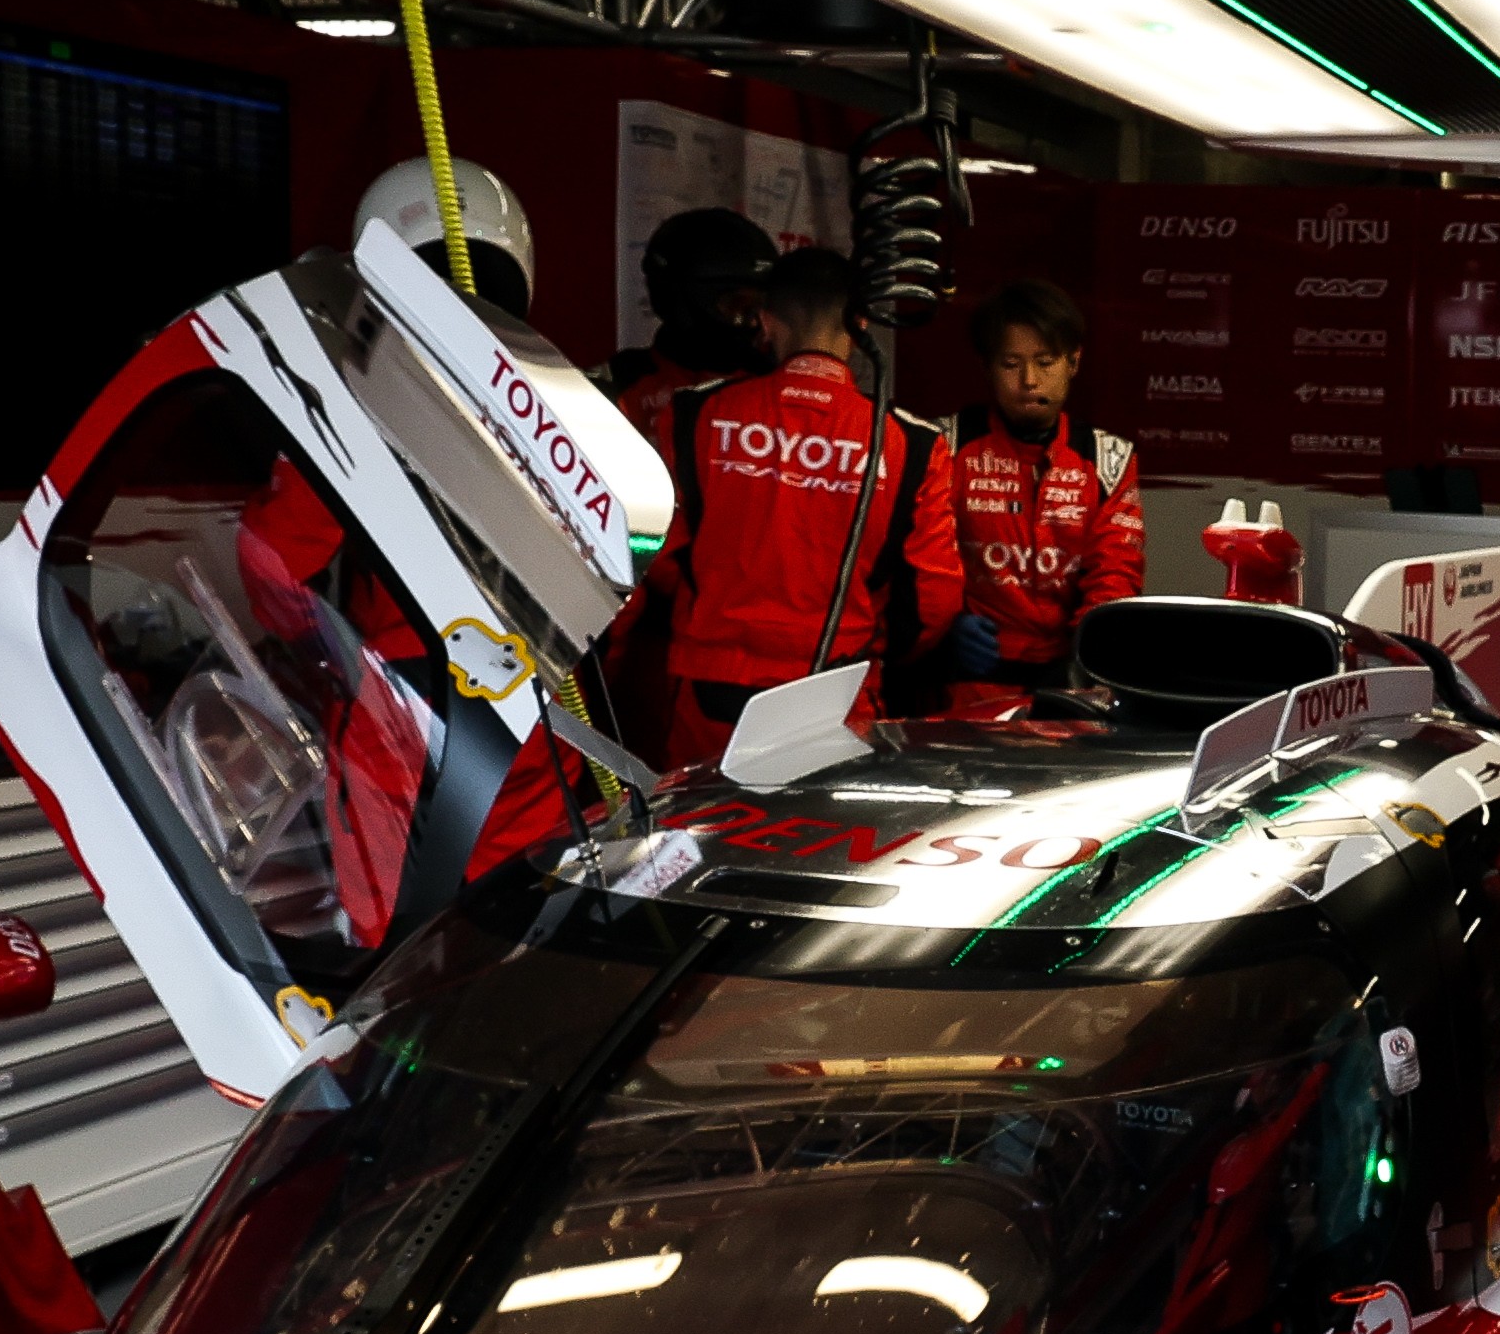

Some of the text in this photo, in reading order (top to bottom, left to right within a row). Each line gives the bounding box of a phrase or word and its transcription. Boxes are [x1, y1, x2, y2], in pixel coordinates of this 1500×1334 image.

[1140, 216, 1238, 240] DENSO
[1297, 215, 1390, 249] FUJITSU
[1146, 374, 1224, 394] MAEDA
[491, 349, 612, 532] TOYOTA
[710, 419, 888, 480] TOYOTA
[1298, 676, 1369, 733] TOYOTA
[656, 800, 1102, 870] DENSO
